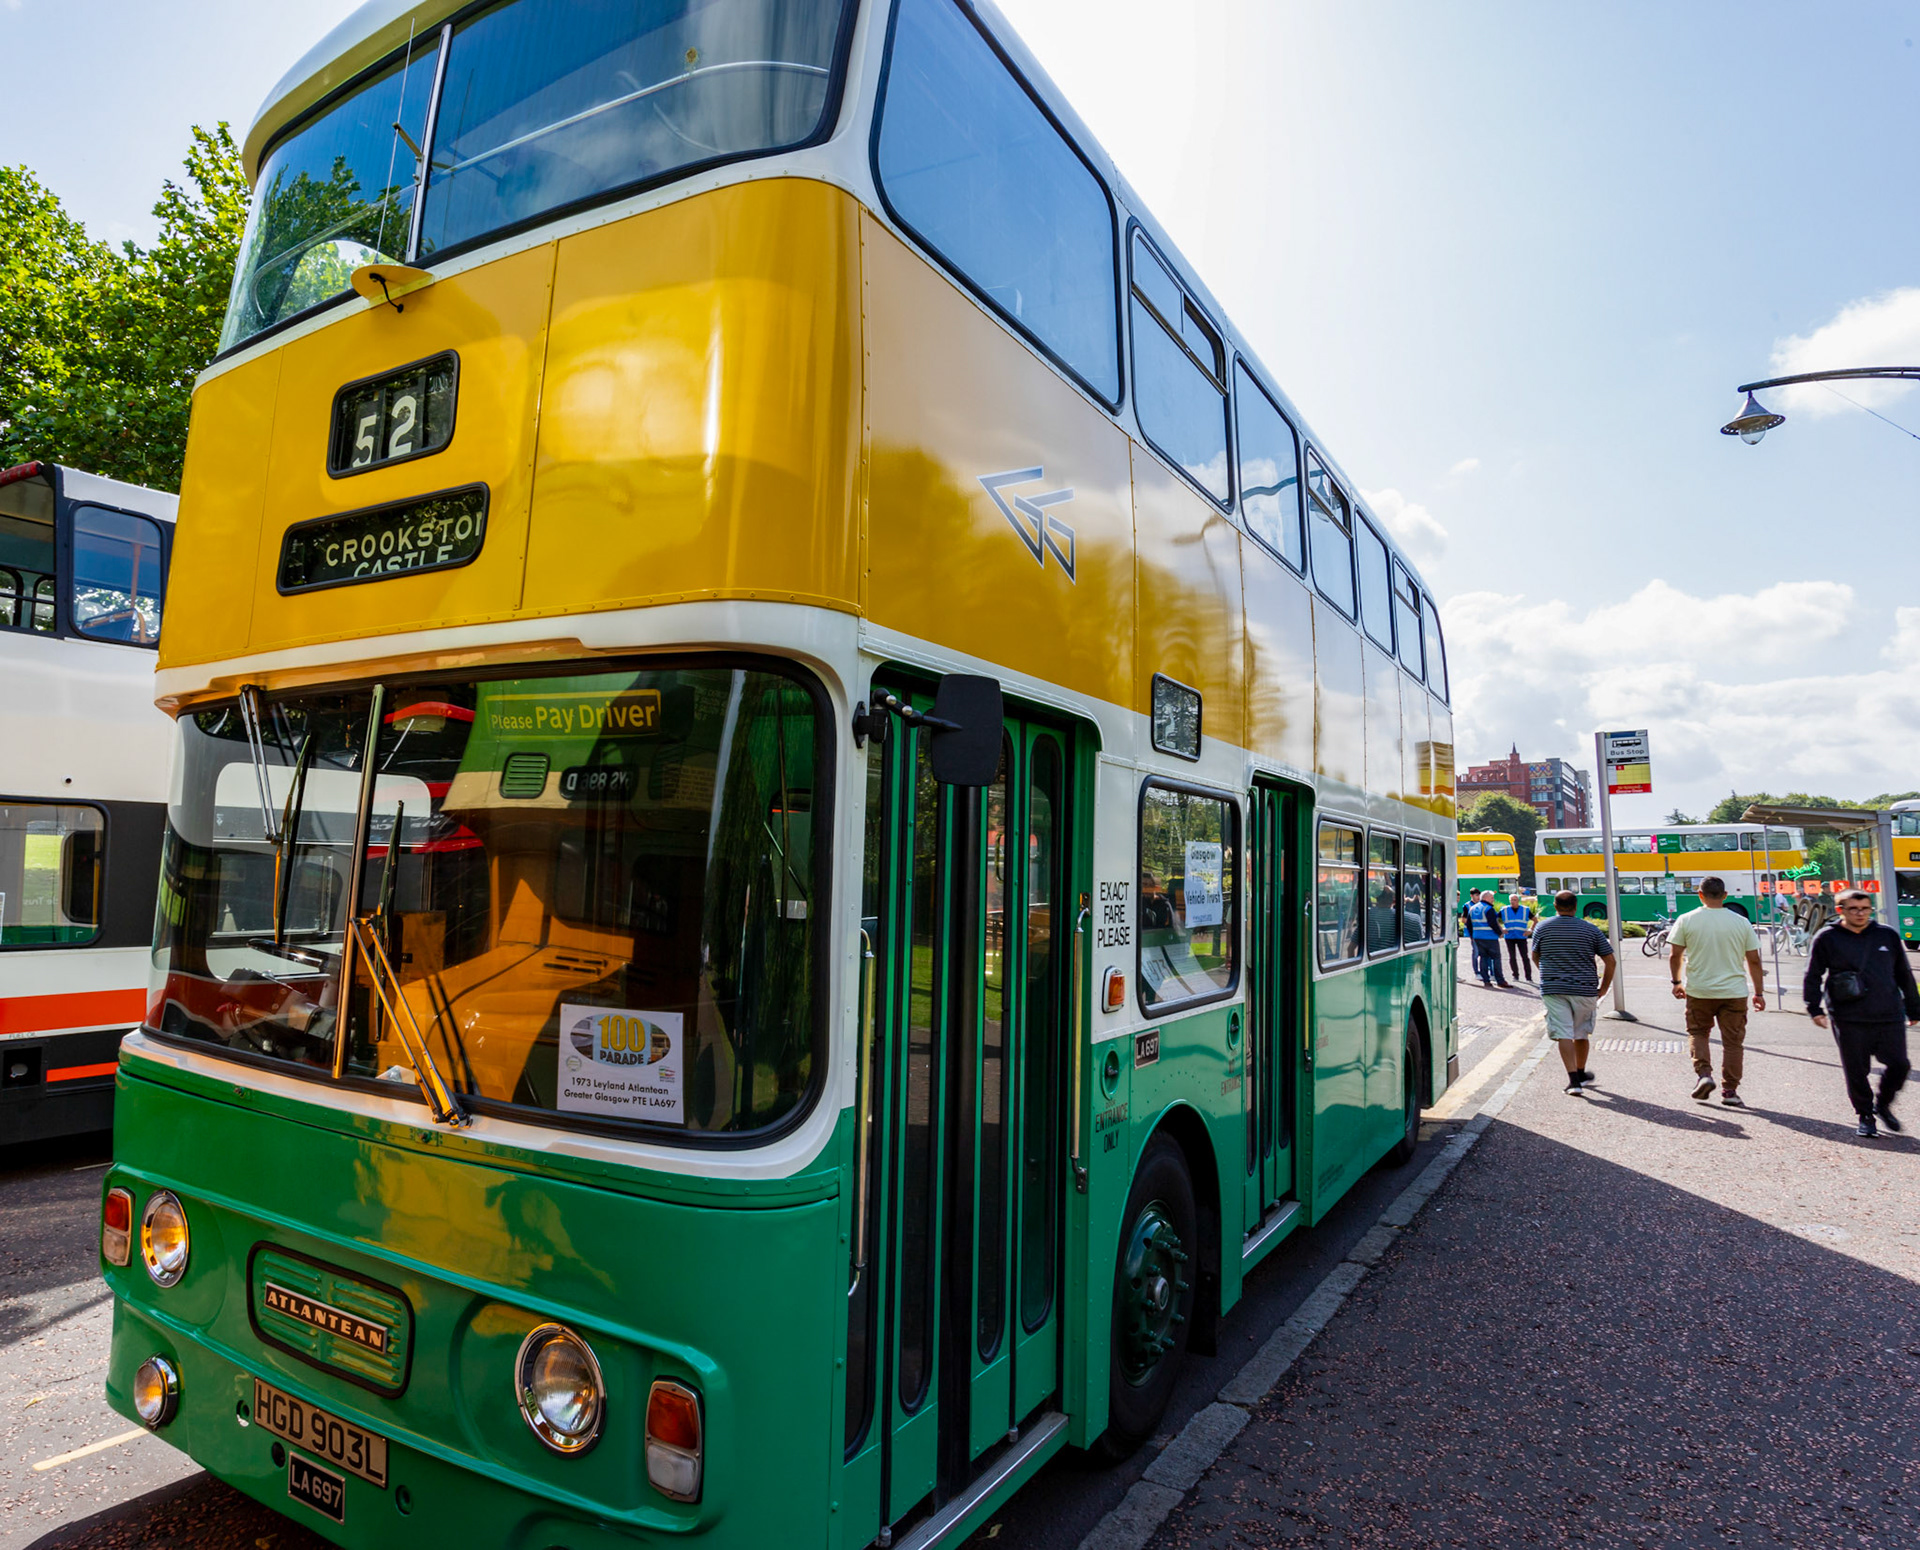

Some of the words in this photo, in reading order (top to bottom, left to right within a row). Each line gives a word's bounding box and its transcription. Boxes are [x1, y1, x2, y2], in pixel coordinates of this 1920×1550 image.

[353, 395, 417, 467] 52
[491, 714, 533, 730] Please
[535, 705, 574, 733] Pay
[578, 700, 656, 729] Driver
[1100, 881, 1130, 901] EXACT
[1103, 904, 1125, 924] FARE
[1097, 926, 1130, 948] PLEASE
[598, 1015, 646, 1053] 100
[600, 1050, 644, 1066] PARADE
[572, 1077, 592, 1087] 1973
[593, 1079, 625, 1091] Leyland
[627, 1083, 669, 1095] Atlantean
[564, 1089, 593, 1100] Greater
[594, 1092, 630, 1104] Glasgow
[632, 1096, 647, 1106] PTE
[649, 1098, 676, 1109] LA697
[1095, 1102, 1128, 1133] ENTRANCE
[1103, 1129, 1120, 1153] ONLY
[267, 1291, 383, 1348] ATLANTEAN
[257, 1384, 304, 1440] HGD
[311, 1414, 384, 1481] 903L
